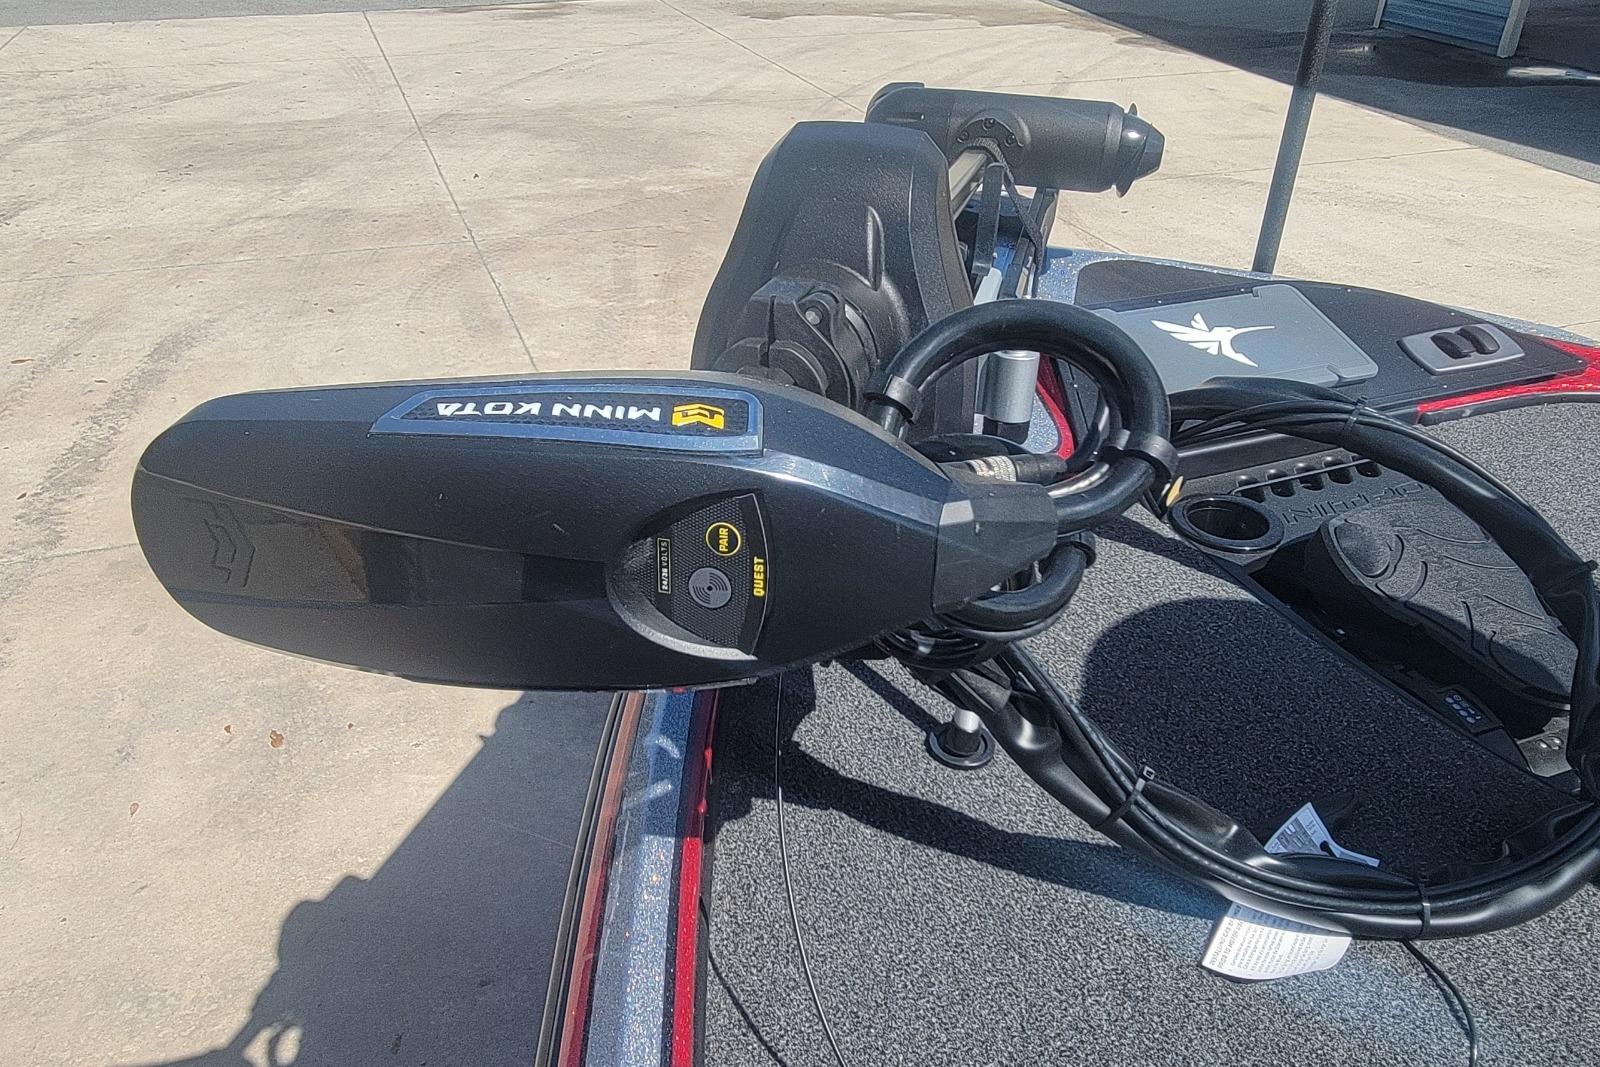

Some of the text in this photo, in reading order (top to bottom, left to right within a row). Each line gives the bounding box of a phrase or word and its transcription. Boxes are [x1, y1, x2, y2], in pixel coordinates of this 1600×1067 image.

[436, 401, 661, 422] MINN KOTA
[718, 527, 729, 552] PAIR
[660, 540, 668, 566] VOLTS
[753, 555, 765, 598] QUEST
